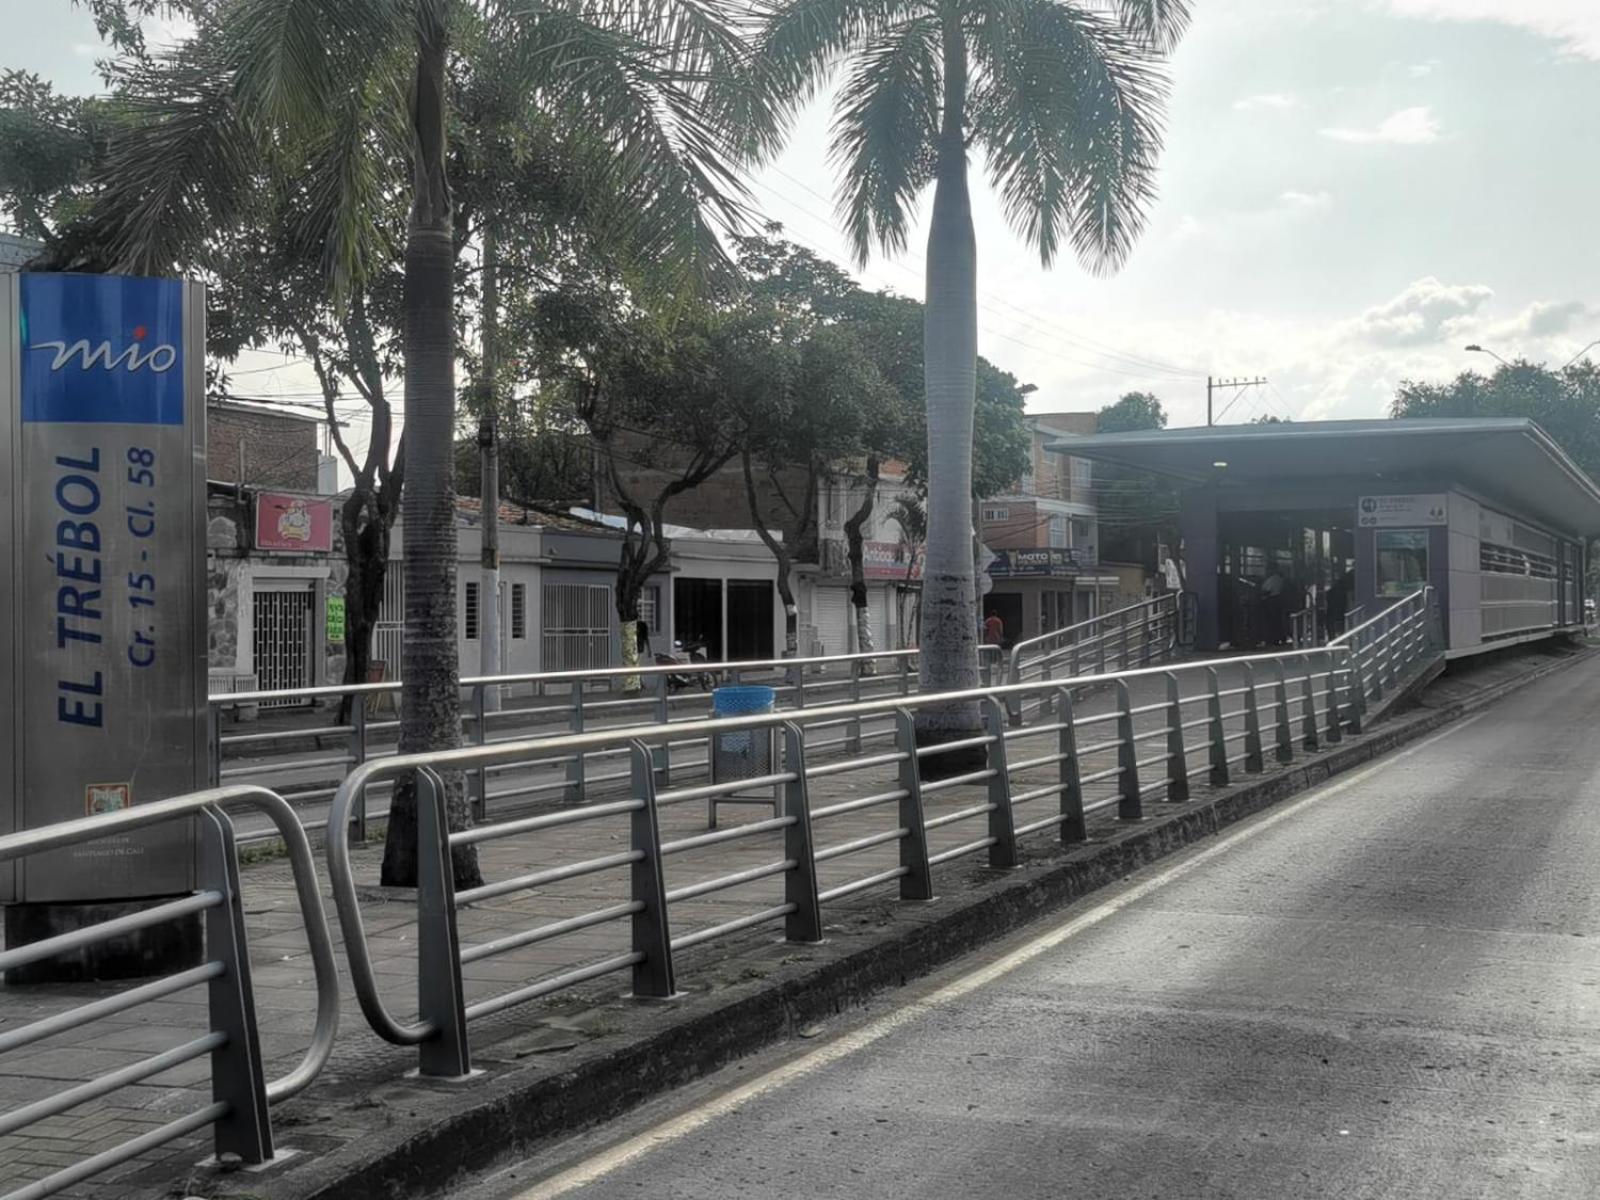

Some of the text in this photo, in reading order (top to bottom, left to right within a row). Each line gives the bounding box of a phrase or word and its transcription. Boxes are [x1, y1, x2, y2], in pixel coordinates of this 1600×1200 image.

[30, 325, 176, 372] mio
[127, 446, 155, 488] 58
[46, 447, 103, 728] EL TRÉBOL
[128, 571, 155, 608] 15
[128, 625, 155, 667] Cr.
